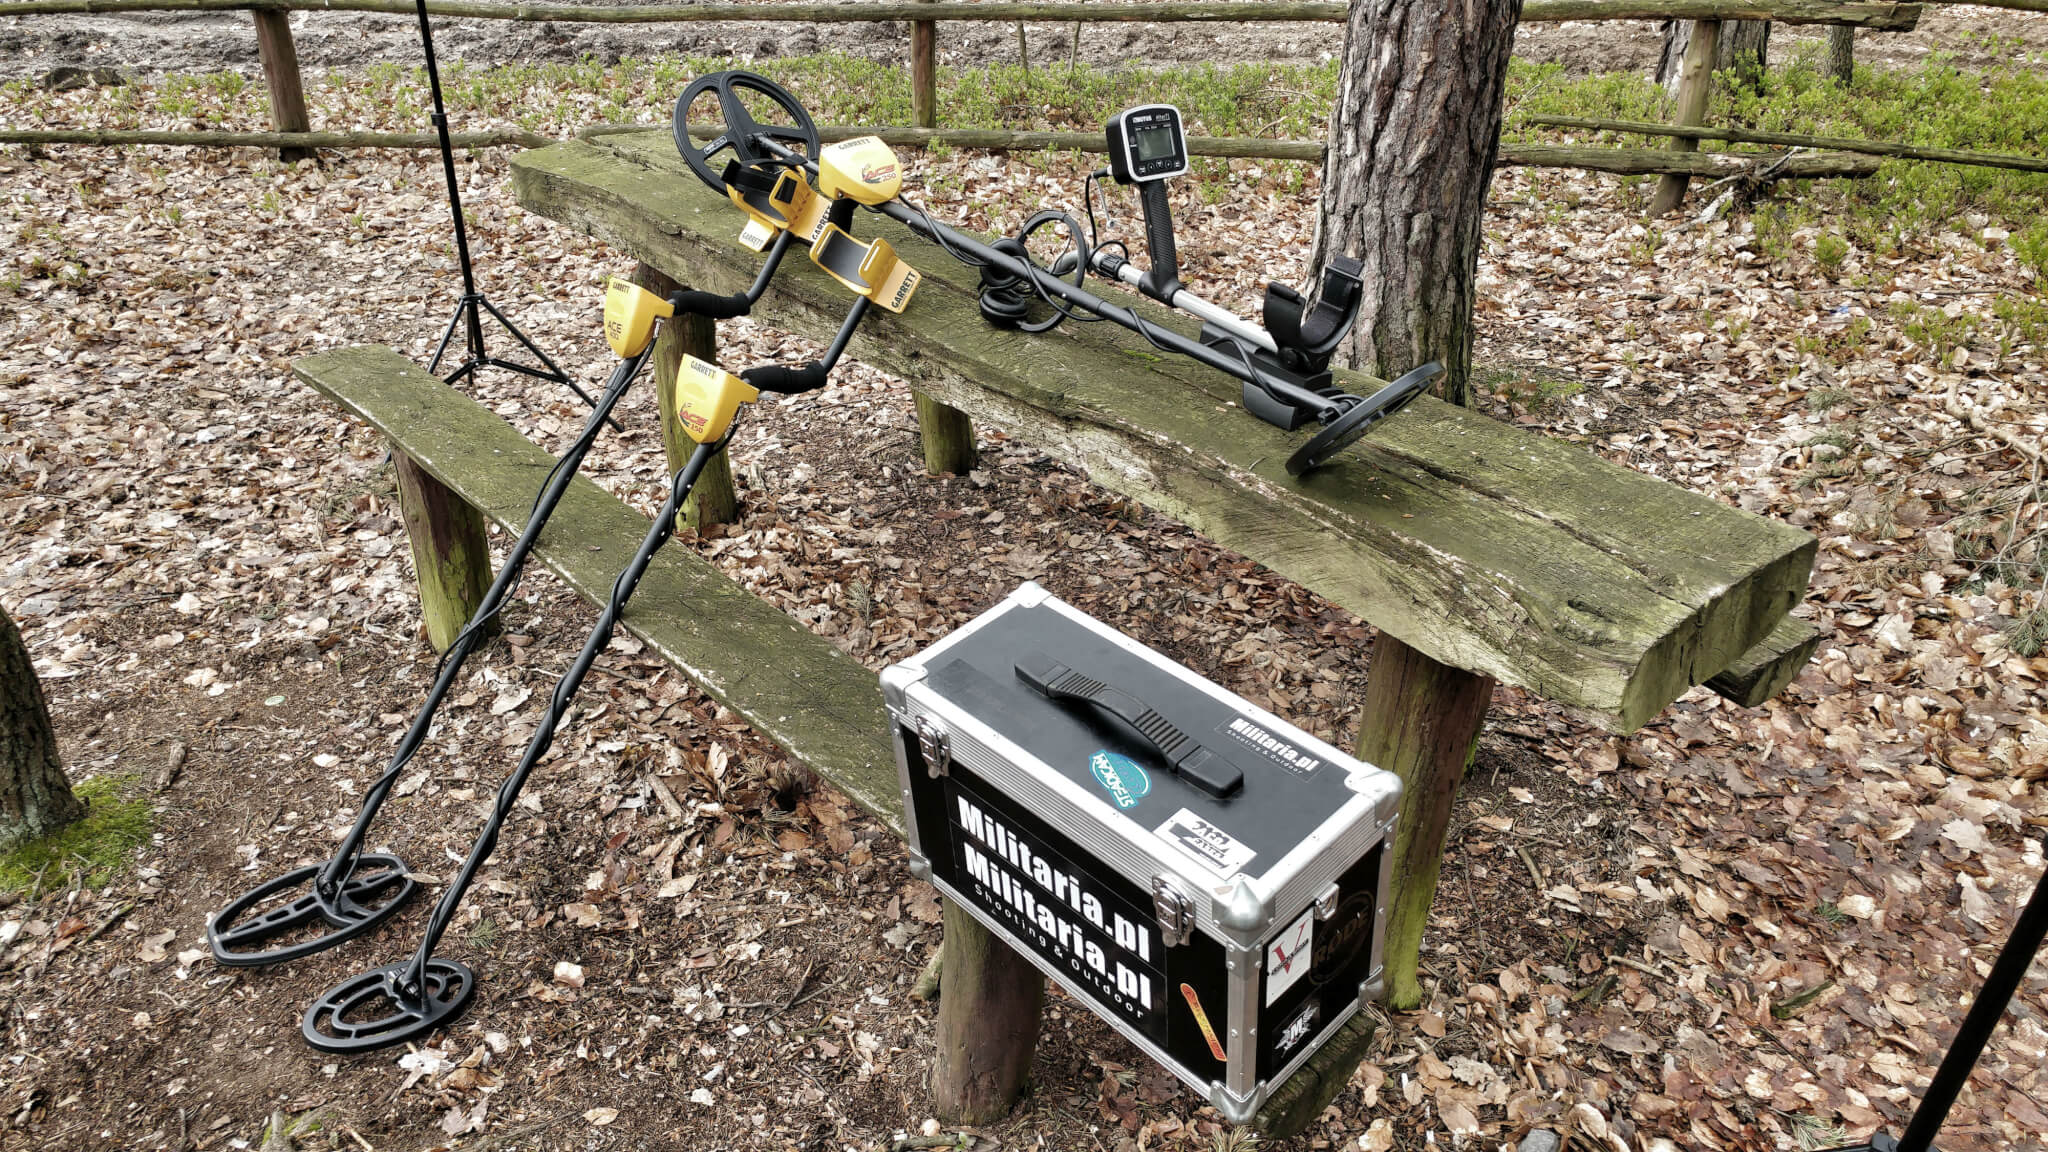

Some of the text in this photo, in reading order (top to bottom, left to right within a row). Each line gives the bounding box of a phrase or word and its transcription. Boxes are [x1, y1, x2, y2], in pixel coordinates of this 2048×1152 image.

[891, 271, 916, 308] GARRETT
[608, 320, 623, 334] ACE
[690, 360, 716, 379] GARRETT
[679, 410, 709, 427] ACE
[1226, 729, 1261, 752] Shooting
[1270, 754, 1303, 774] Outdoor
[1229, 718, 1320, 771] Militaria.pl
[958, 795, 1150, 963] Militaria.pl
[964, 841, 1152, 1010] Militaria.pl
[974, 883, 1144, 1019] Shooting & Outdoor
